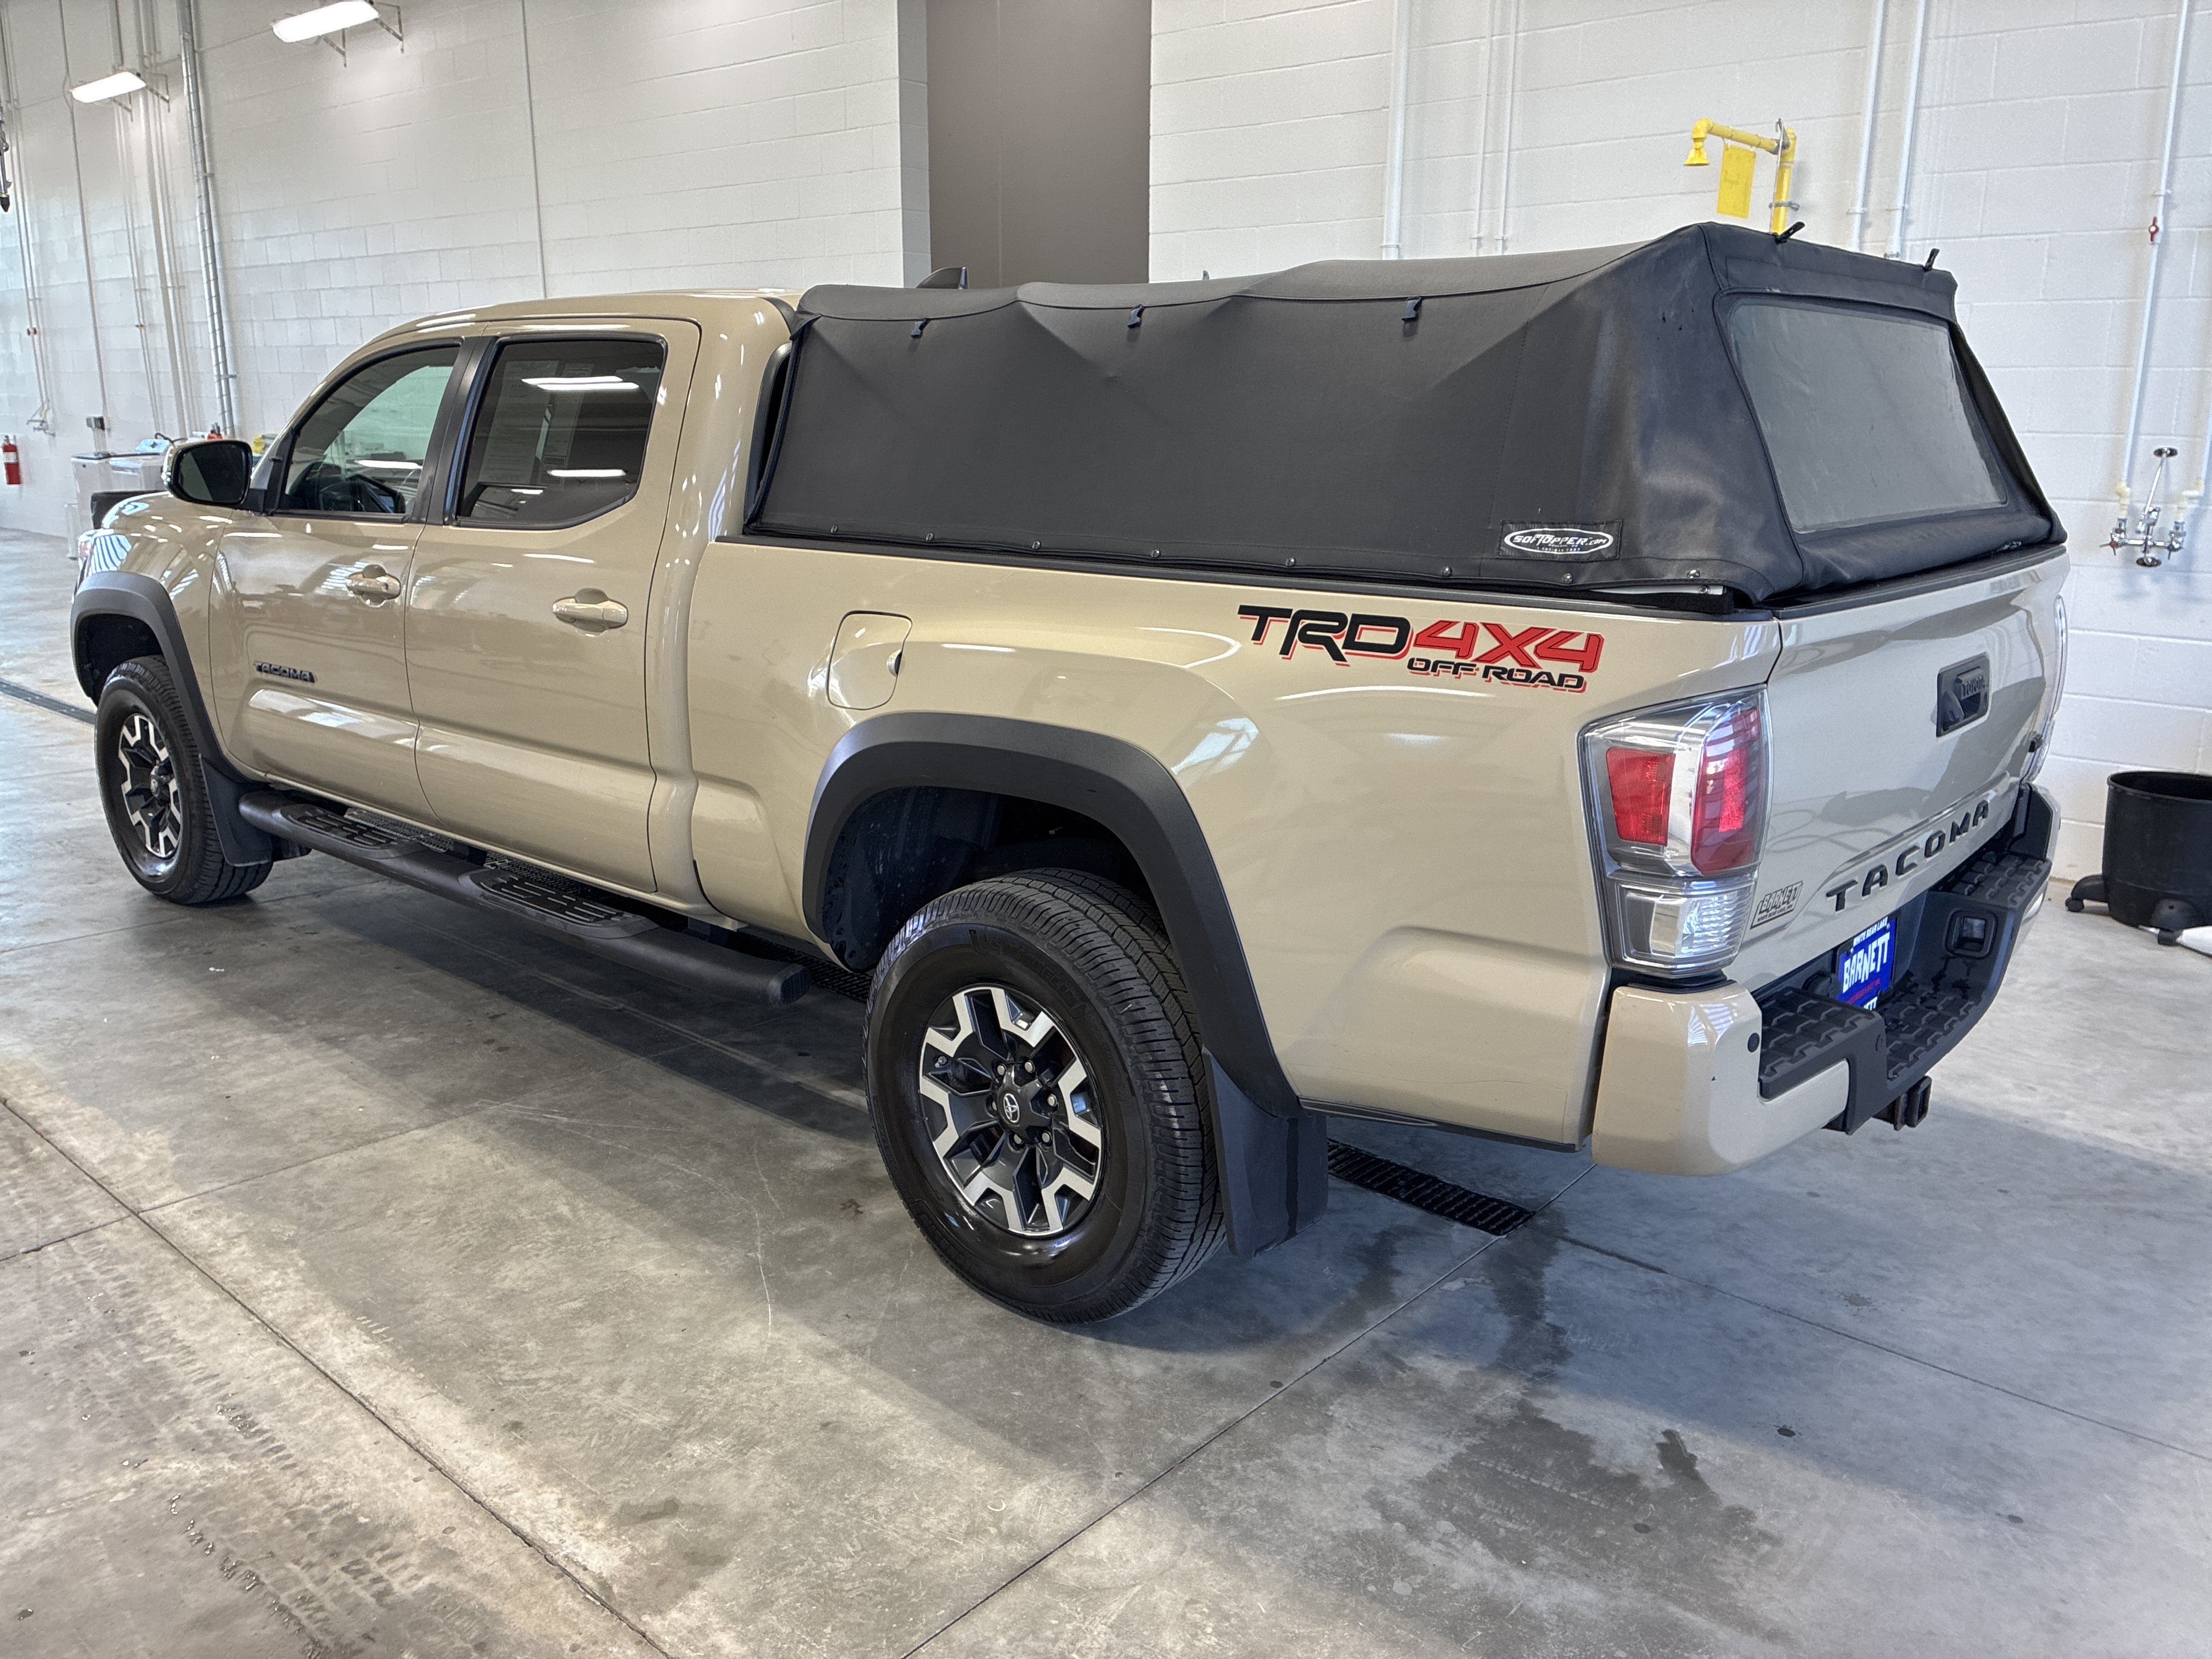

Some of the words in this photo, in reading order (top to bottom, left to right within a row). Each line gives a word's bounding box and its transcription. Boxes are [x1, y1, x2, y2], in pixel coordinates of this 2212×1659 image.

[1238, 605, 1413, 665] TRD
[1414, 619, 1605, 673] 4X4
[253, 661, 317, 684] TACOMA
[1407, 657, 1479, 679] OFF
[1482, 665, 1586, 693] ROAD
[1826, 799, 1989, 912] TACOMA
[1758, 881, 1803, 915] BARNETT
[1853, 931, 1866, 947] WHITE
[1866, 923, 1877, 939] BEAR
[1877, 916, 1888, 931] LAKE
[1843, 932, 1891, 994] BARNETT
